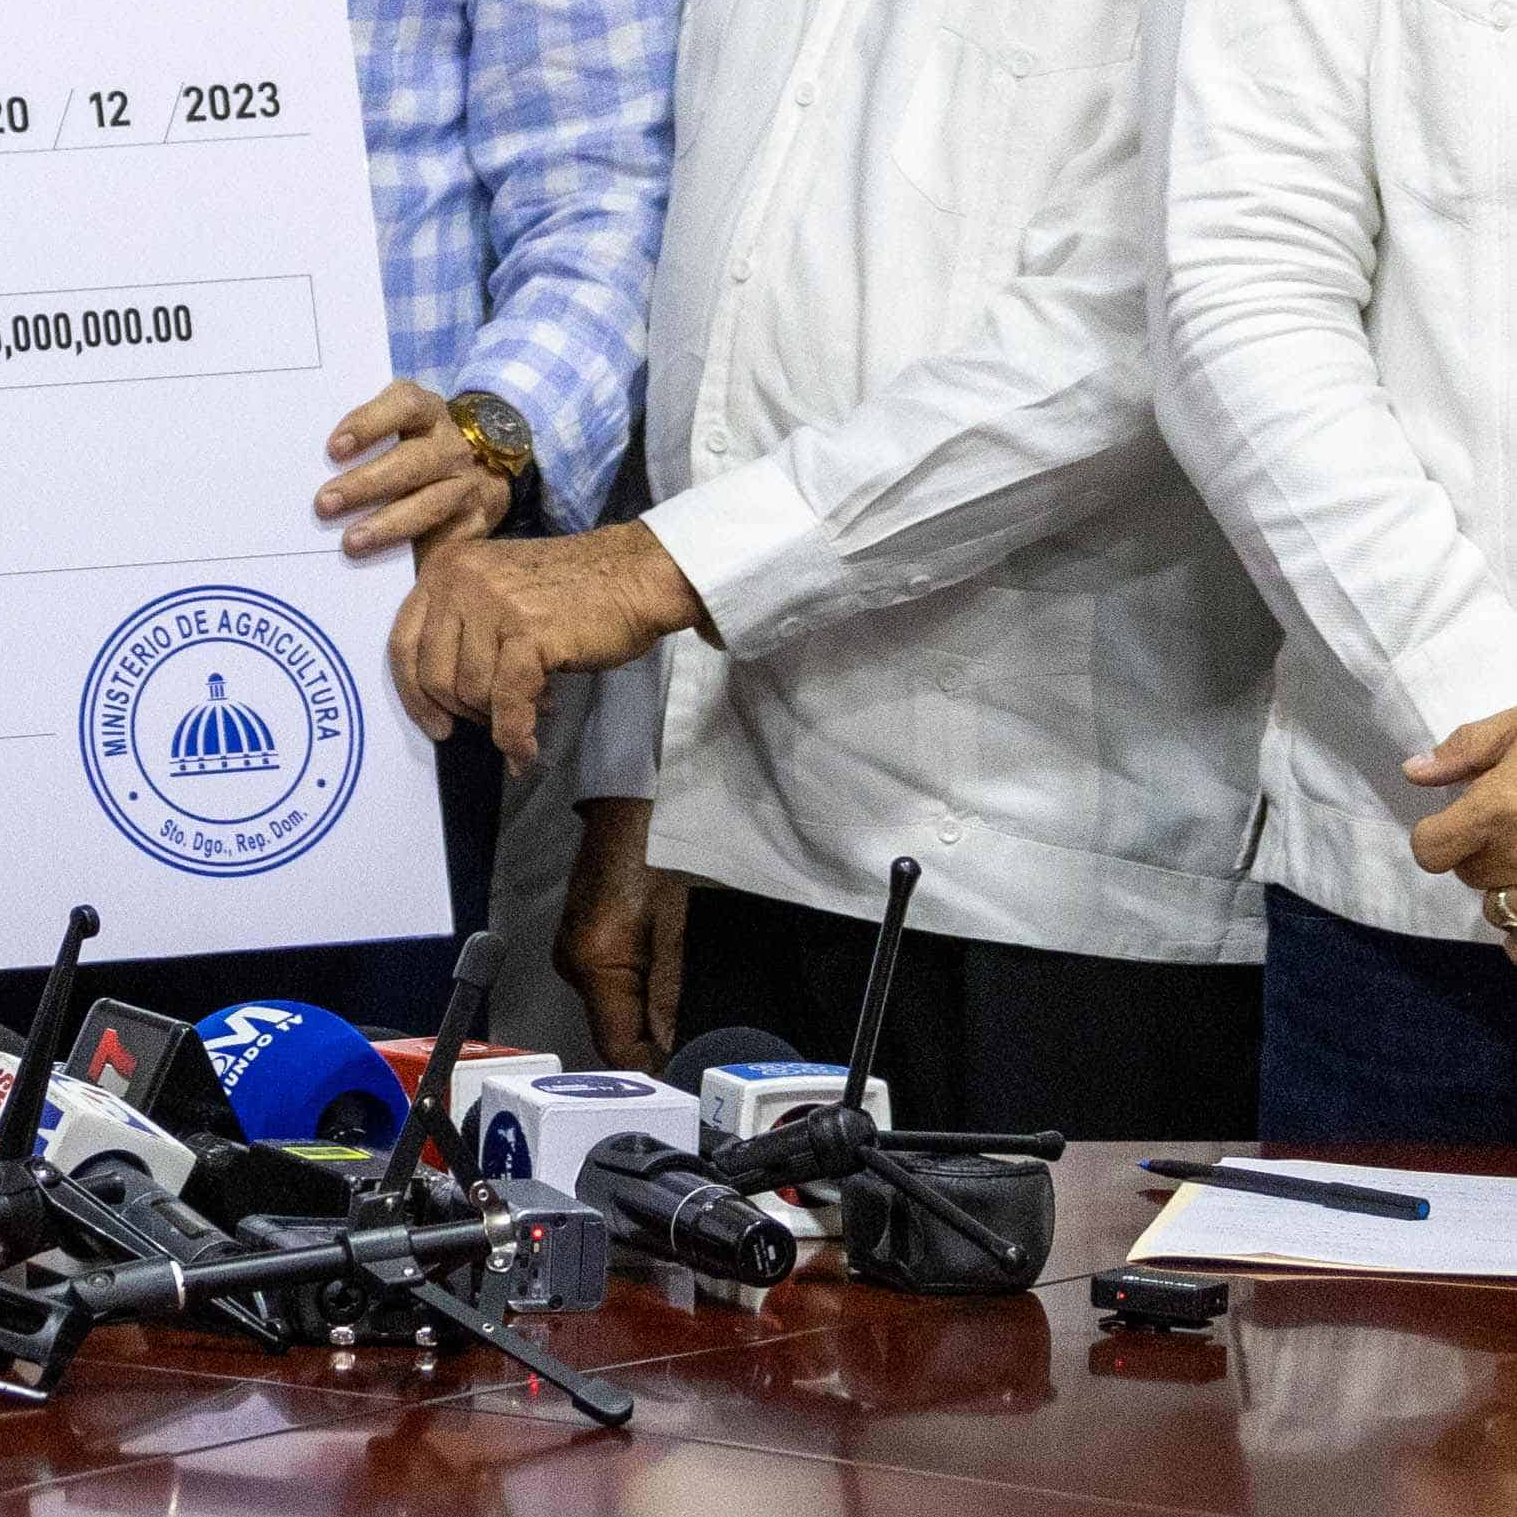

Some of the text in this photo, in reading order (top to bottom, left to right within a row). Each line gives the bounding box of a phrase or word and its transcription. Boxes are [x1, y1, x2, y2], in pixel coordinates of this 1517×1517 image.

[89, 90, 131, 128] 12
[101, 608, 342, 758] MINISTERIO DE AGRICULTURA
[159, 818, 187, 847] Sto.
[236, 828, 271, 854] Rep.
[269, 807, 309, 839] Dom.
[223, 1033, 274, 1097] UNDO
